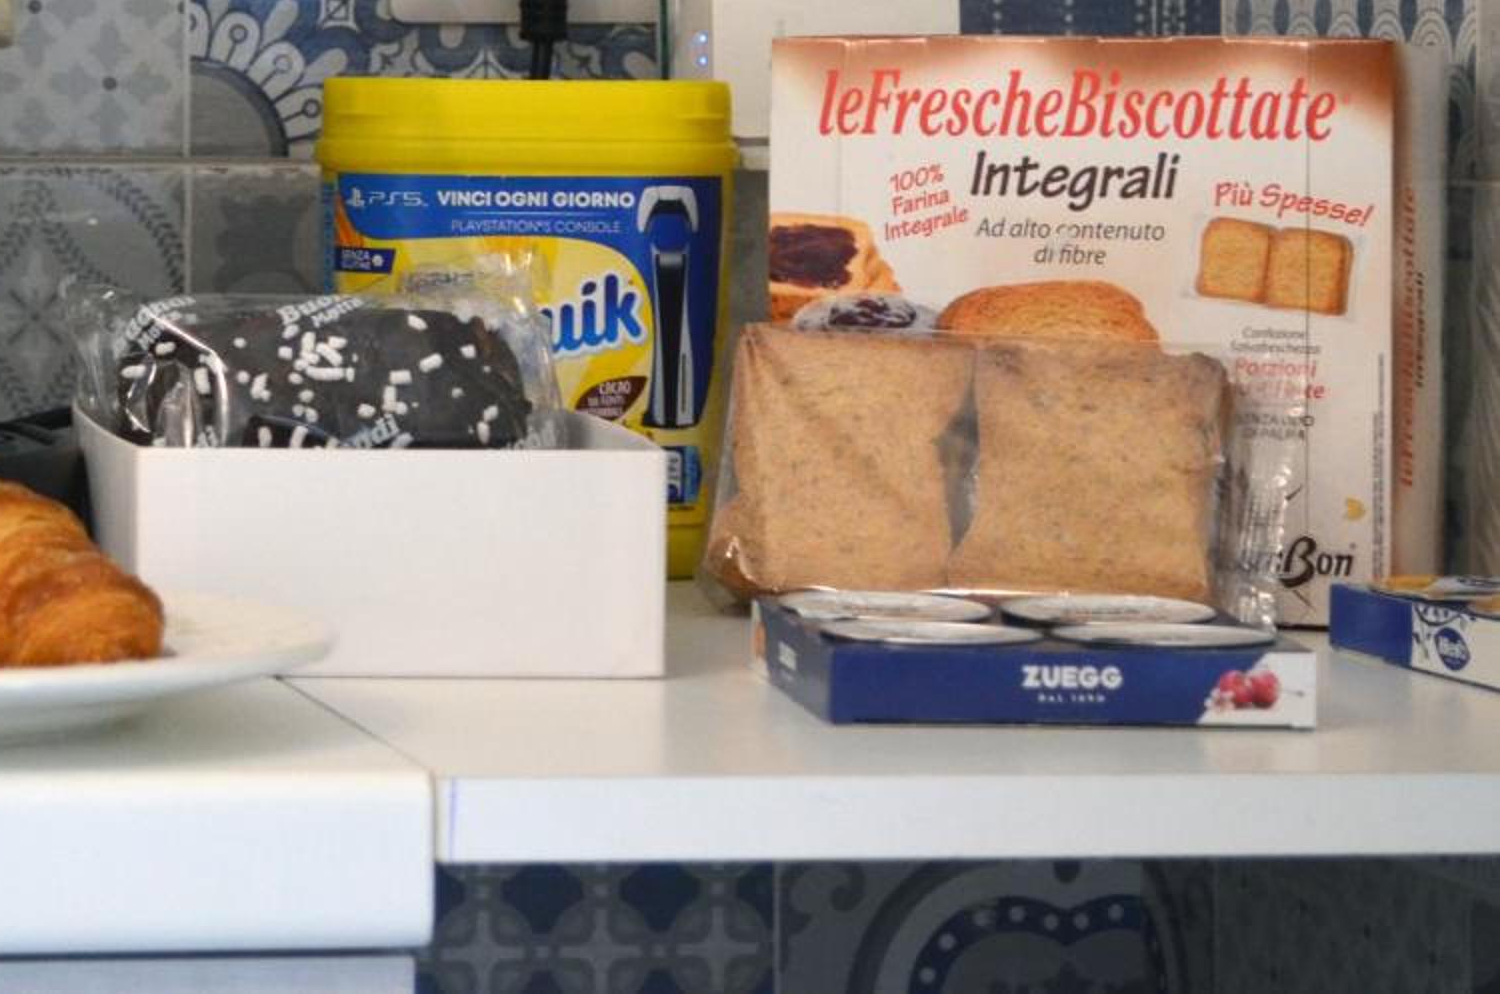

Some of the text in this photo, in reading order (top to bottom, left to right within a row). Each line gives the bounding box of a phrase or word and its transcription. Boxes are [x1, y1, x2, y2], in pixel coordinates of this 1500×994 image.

[818, 69, 1337, 141] leFrescheBiscottate
[890, 163, 944, 193] 100%
[970, 150, 1180, 212] Integrali
[436, 190, 636, 208] VINCI OGNI GIORNO
[891, 188, 950, 216] Farina
[1214, 180, 1374, 227] Più Spesse!
[555, 220, 621, 234] CONSOLE
[884, 205, 970, 242] Integrale
[976, 218, 1166, 241] Ad alto contenuto
[1033, 246, 1107, 265] di fibre
[1021, 664, 1123, 689] ZUEGG
